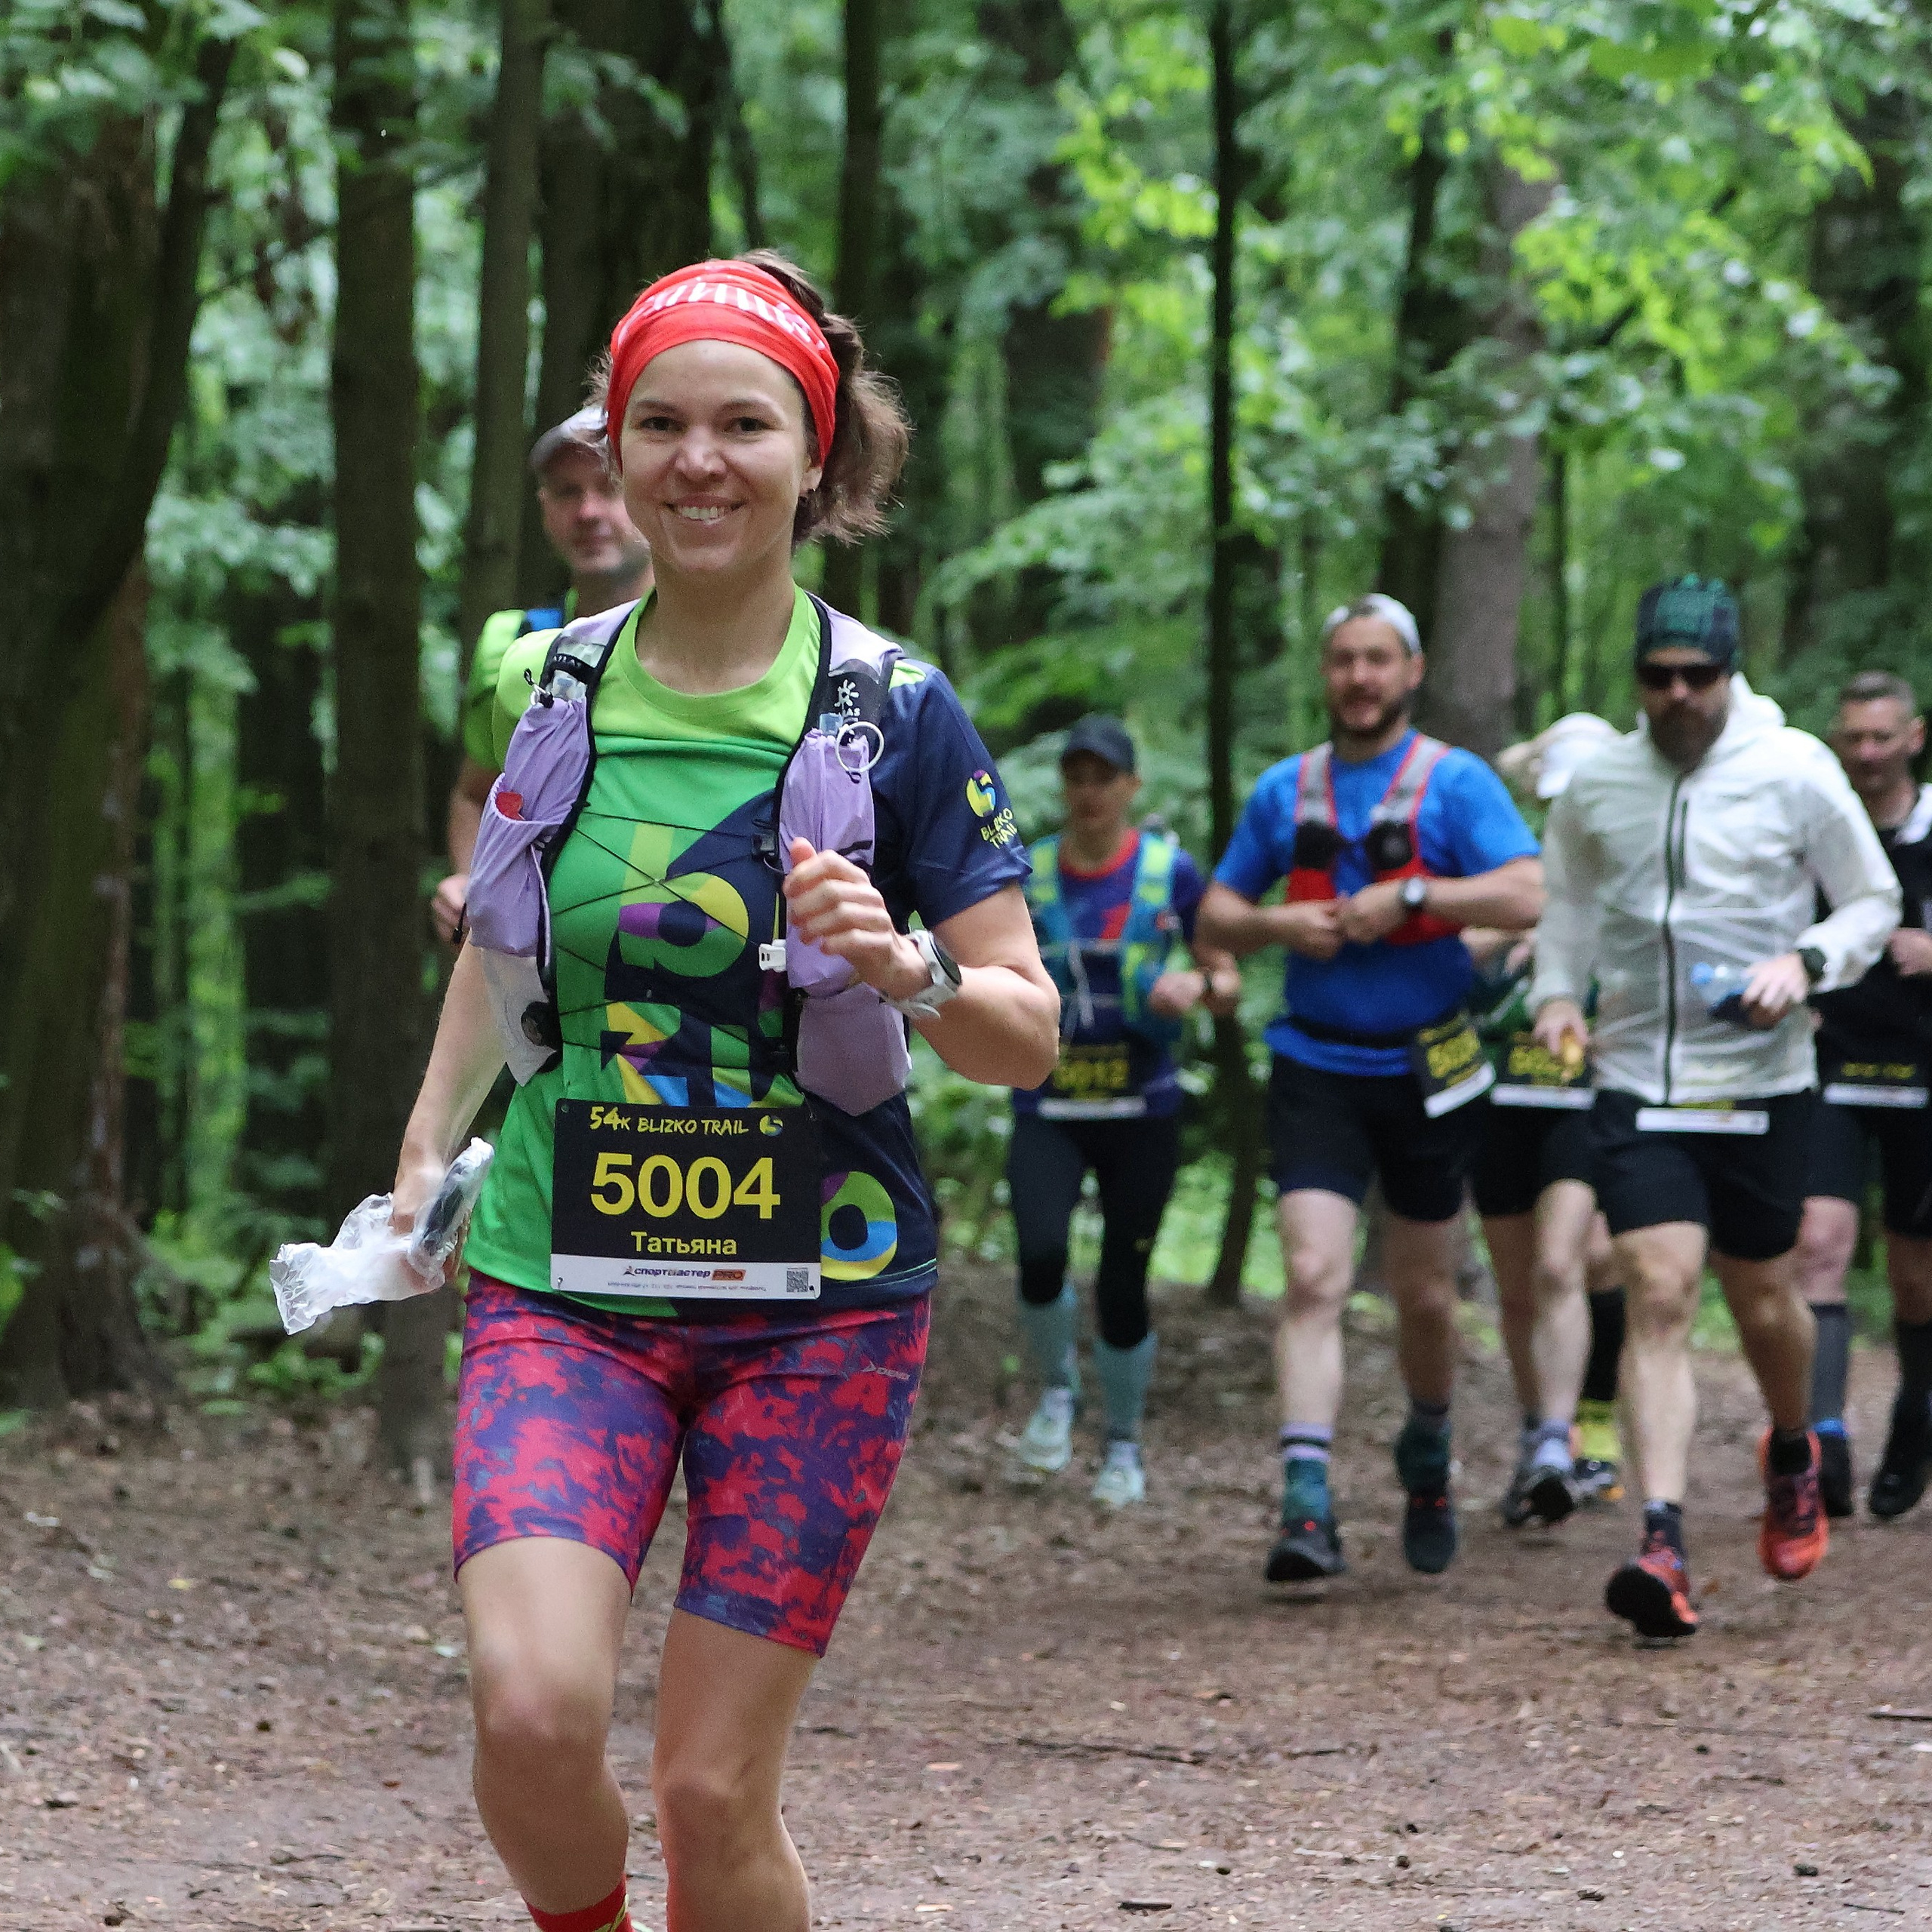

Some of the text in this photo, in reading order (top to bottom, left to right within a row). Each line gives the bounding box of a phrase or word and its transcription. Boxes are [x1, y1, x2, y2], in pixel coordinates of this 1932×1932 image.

[637, 1118, 696, 1134] BLIZKO
[701, 1118, 749, 1135] TRAIL
[591, 1152, 780, 1219] 5004
[631, 1231, 737, 1255] Татьяна
